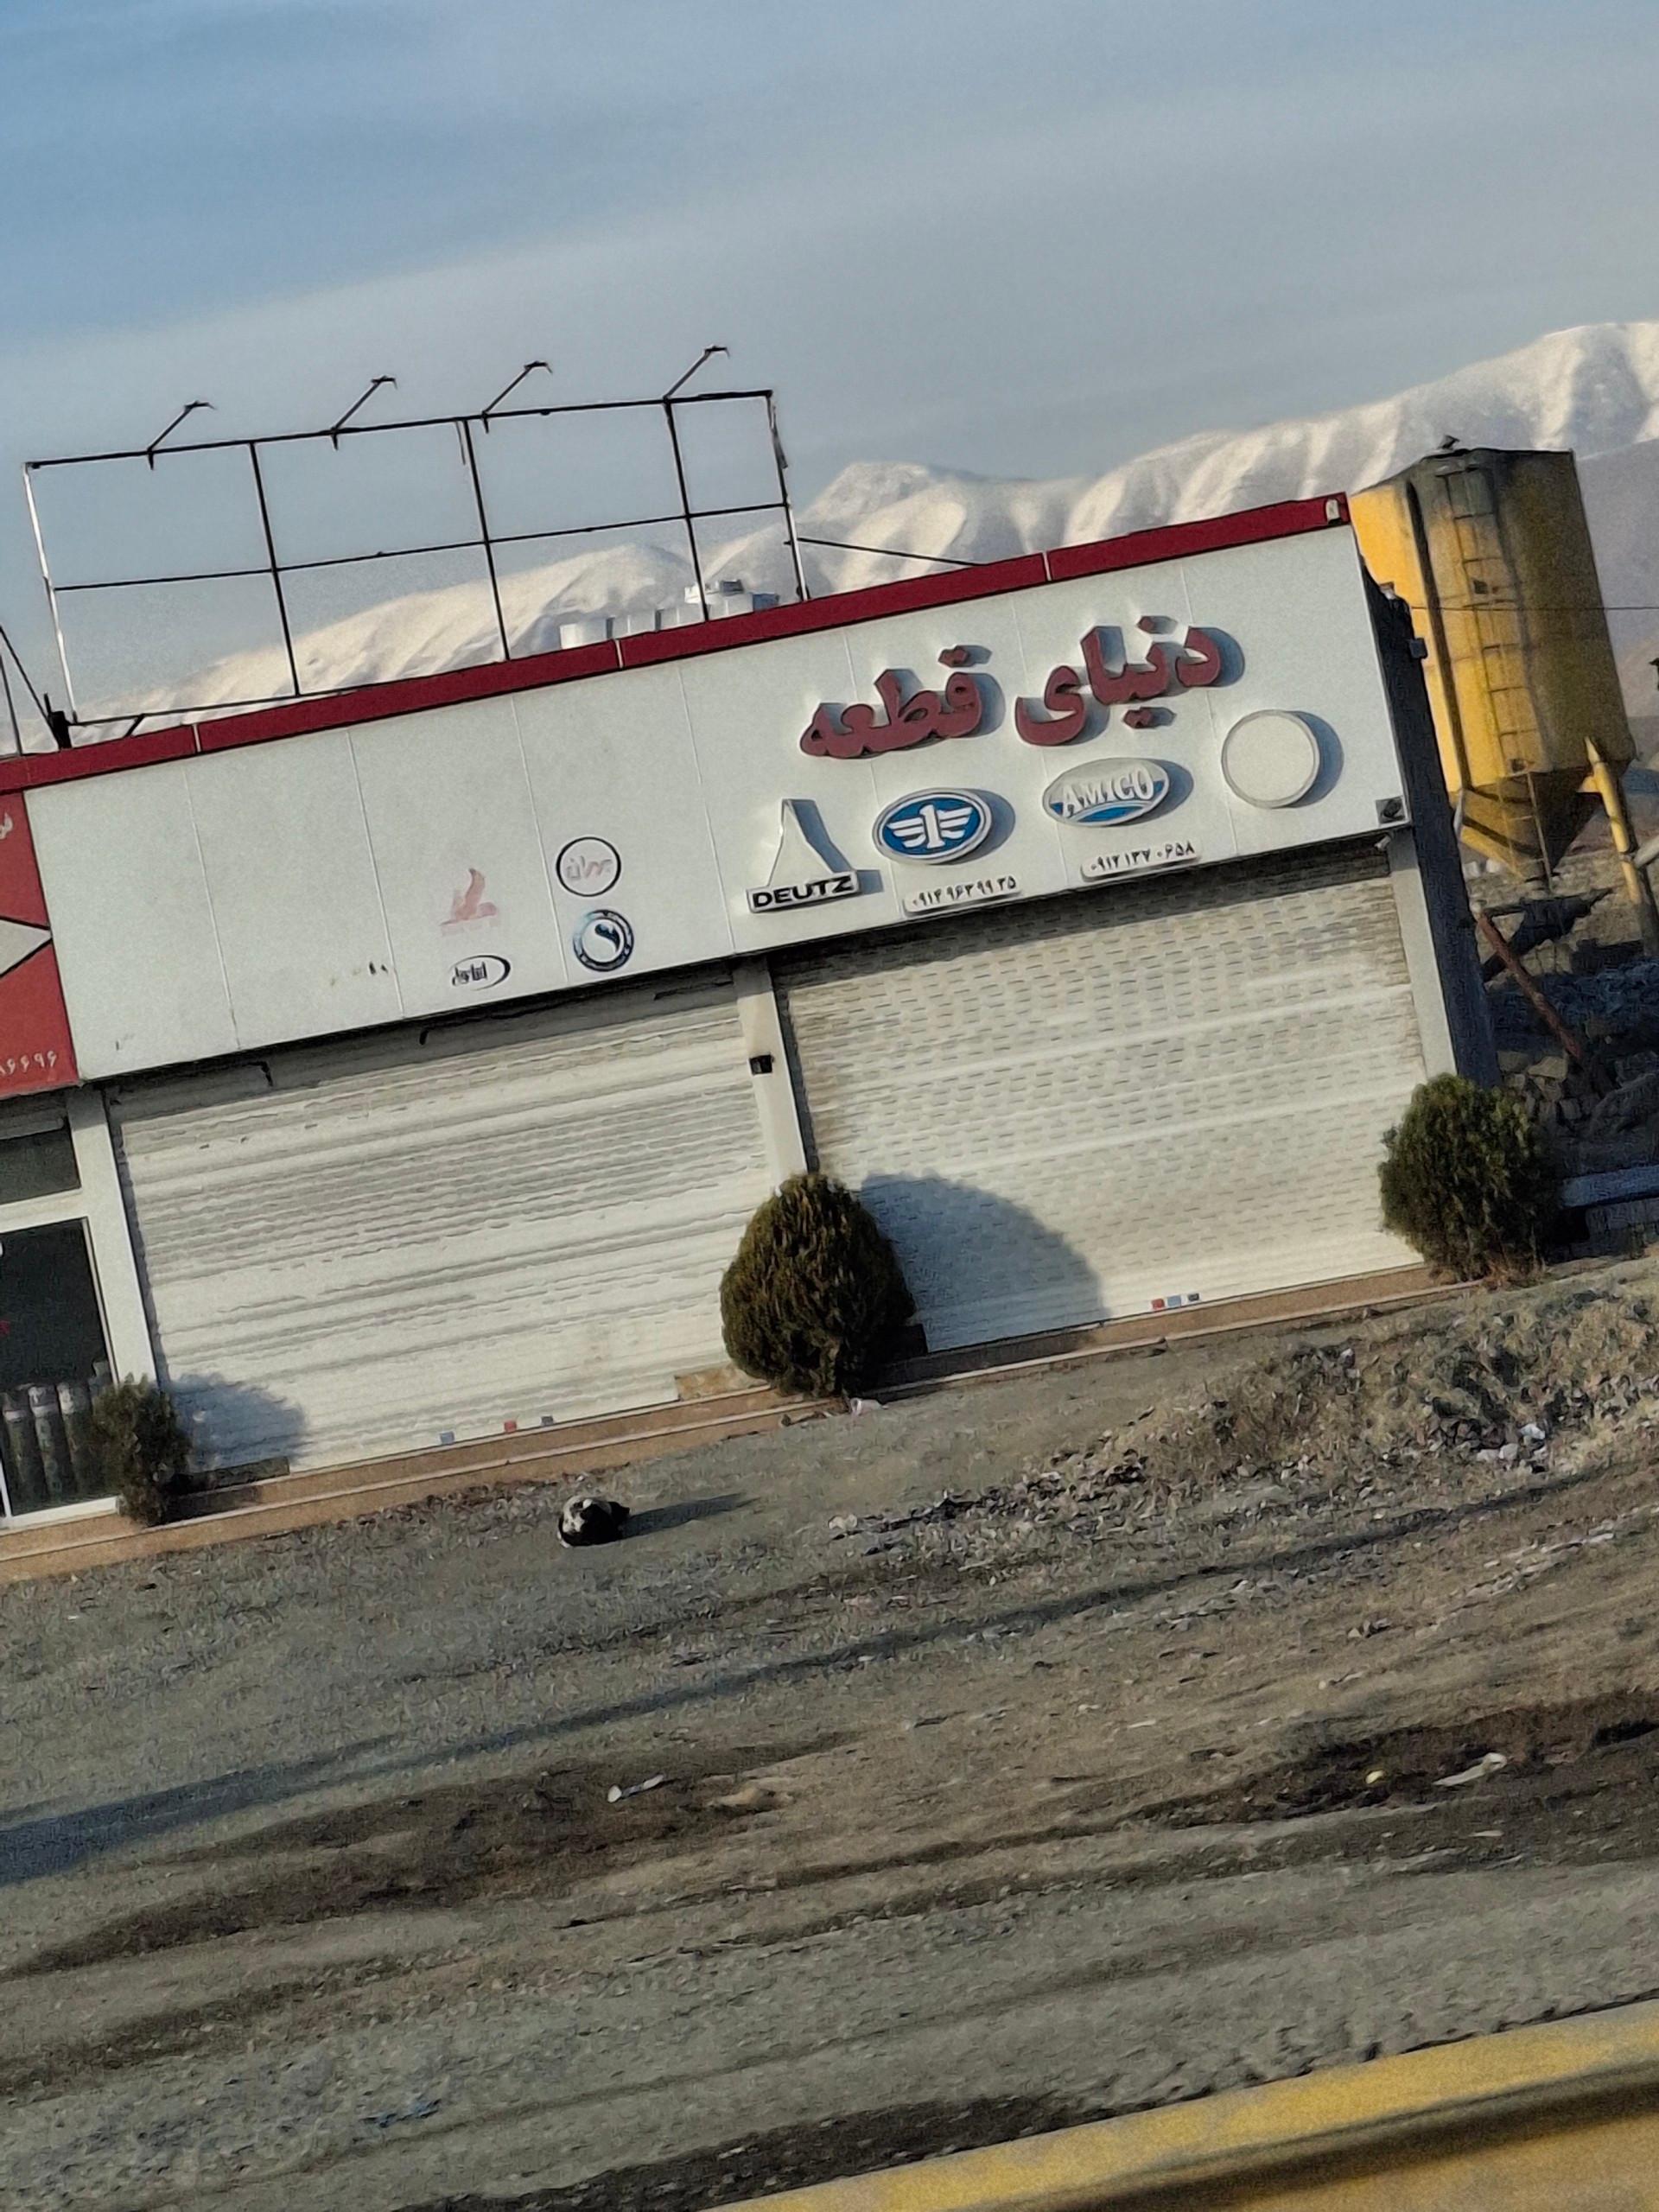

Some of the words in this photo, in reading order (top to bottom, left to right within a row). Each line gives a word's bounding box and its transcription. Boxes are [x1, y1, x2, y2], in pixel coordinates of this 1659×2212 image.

[800, 645, 982, 758] قطعه
[1015, 615, 1220, 746] دنیای
[753, 874, 854, 908] DEUTZ
